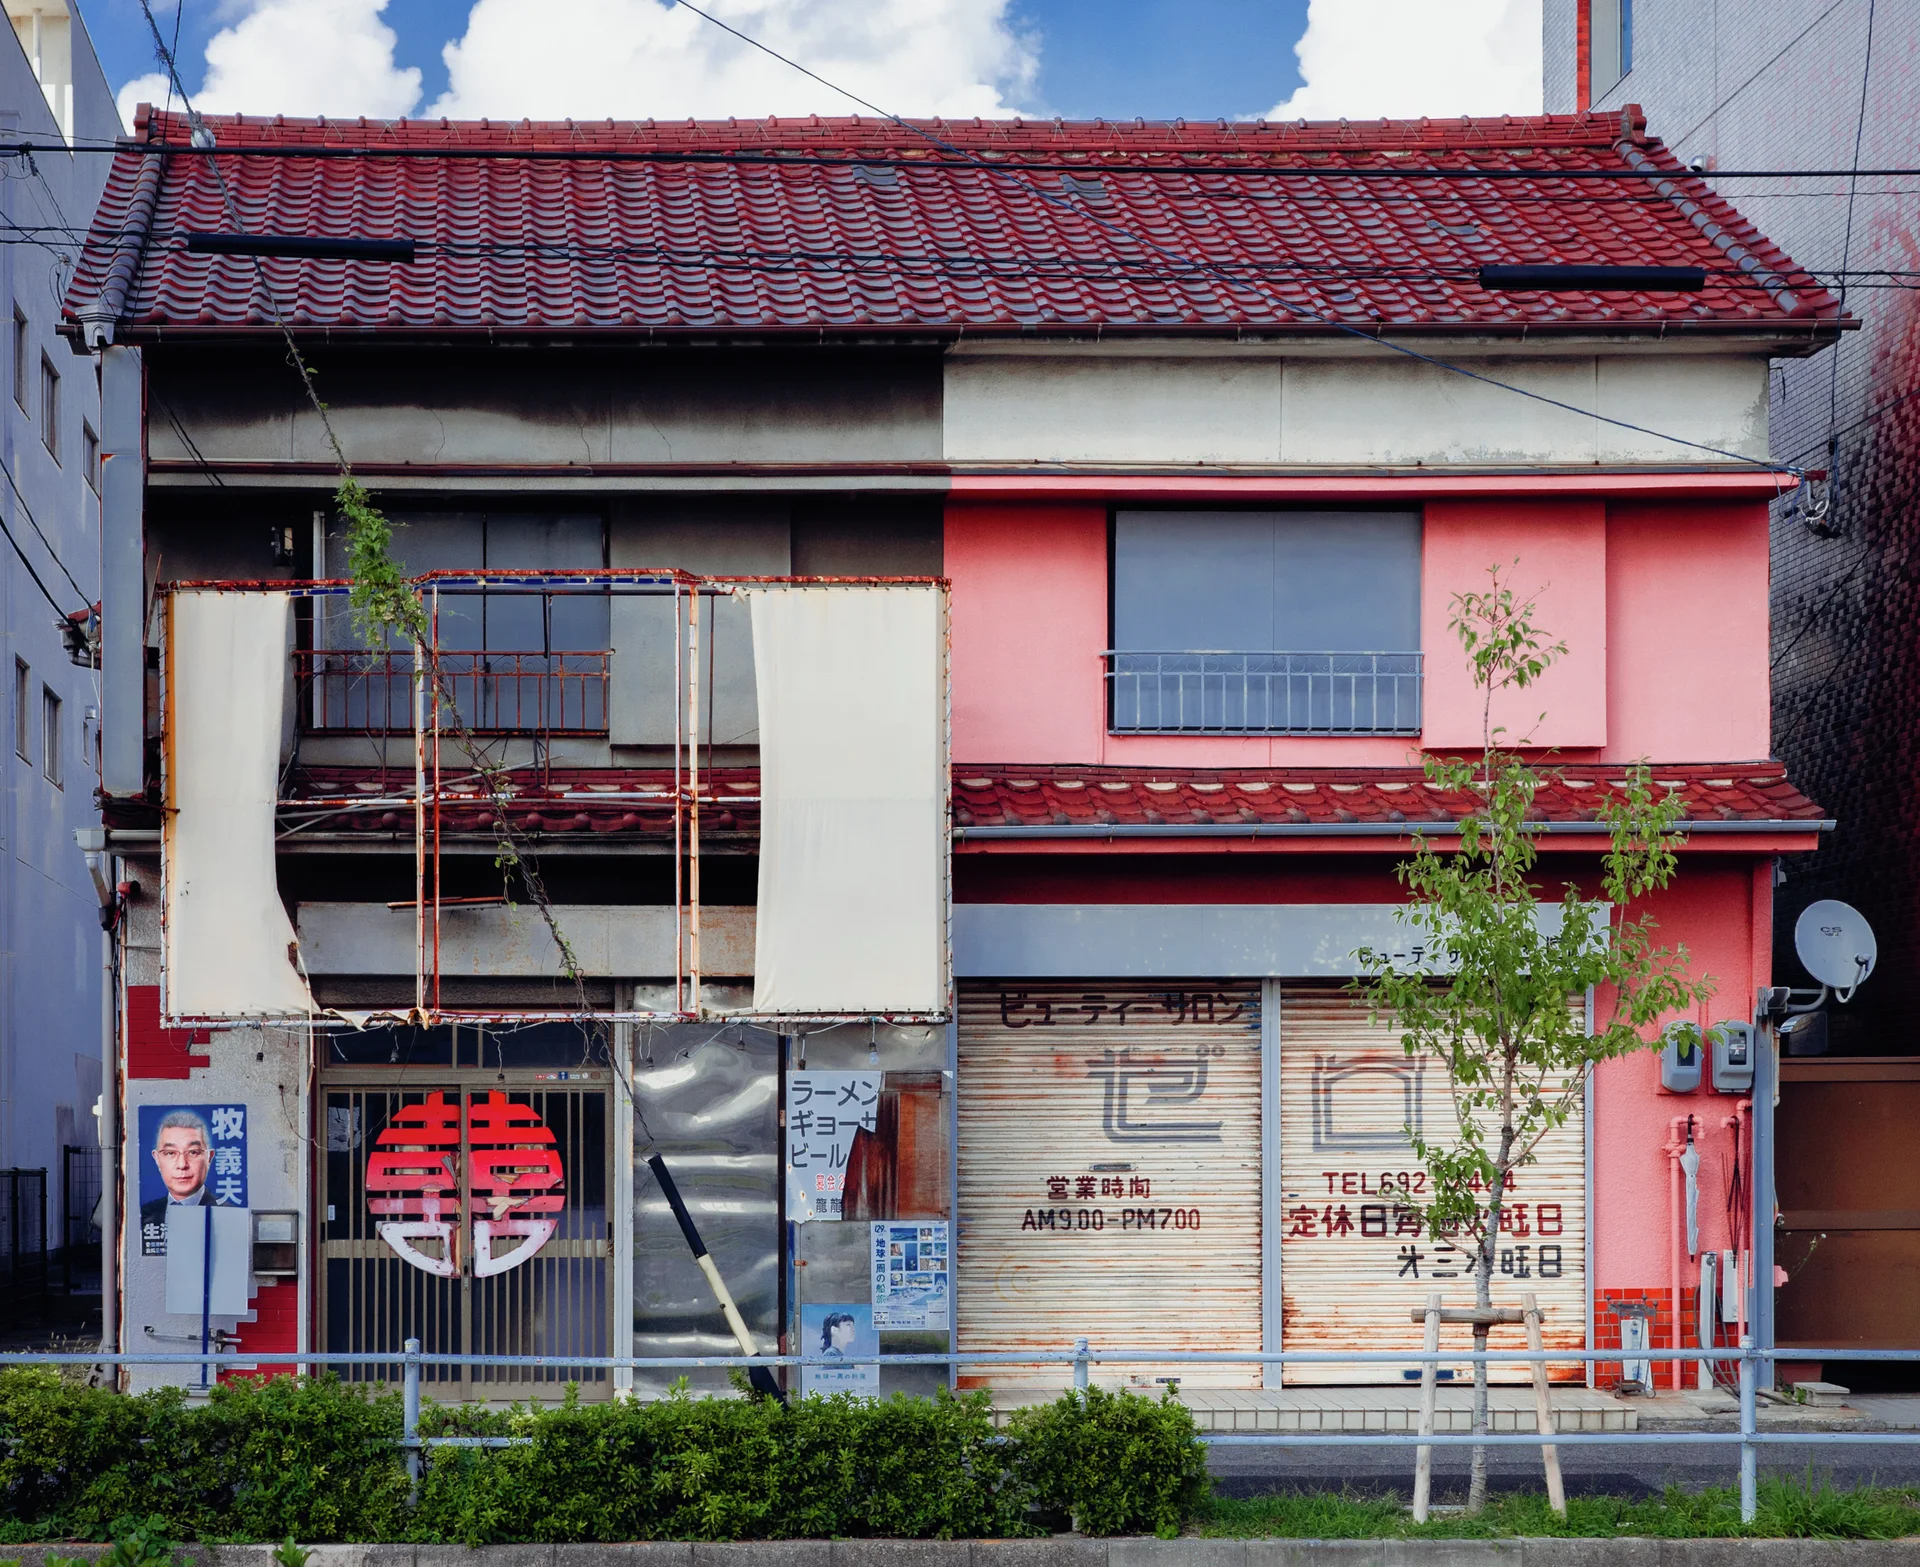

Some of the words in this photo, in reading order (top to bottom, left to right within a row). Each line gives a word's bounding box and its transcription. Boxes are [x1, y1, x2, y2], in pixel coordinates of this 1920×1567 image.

[1000, 993, 1244, 1028] ビューティーサロン
[791, 1080, 878, 1107] ラーメン
[211, 1108, 244, 1205] 牧義夫
[791, 1143, 847, 1168] ビール
